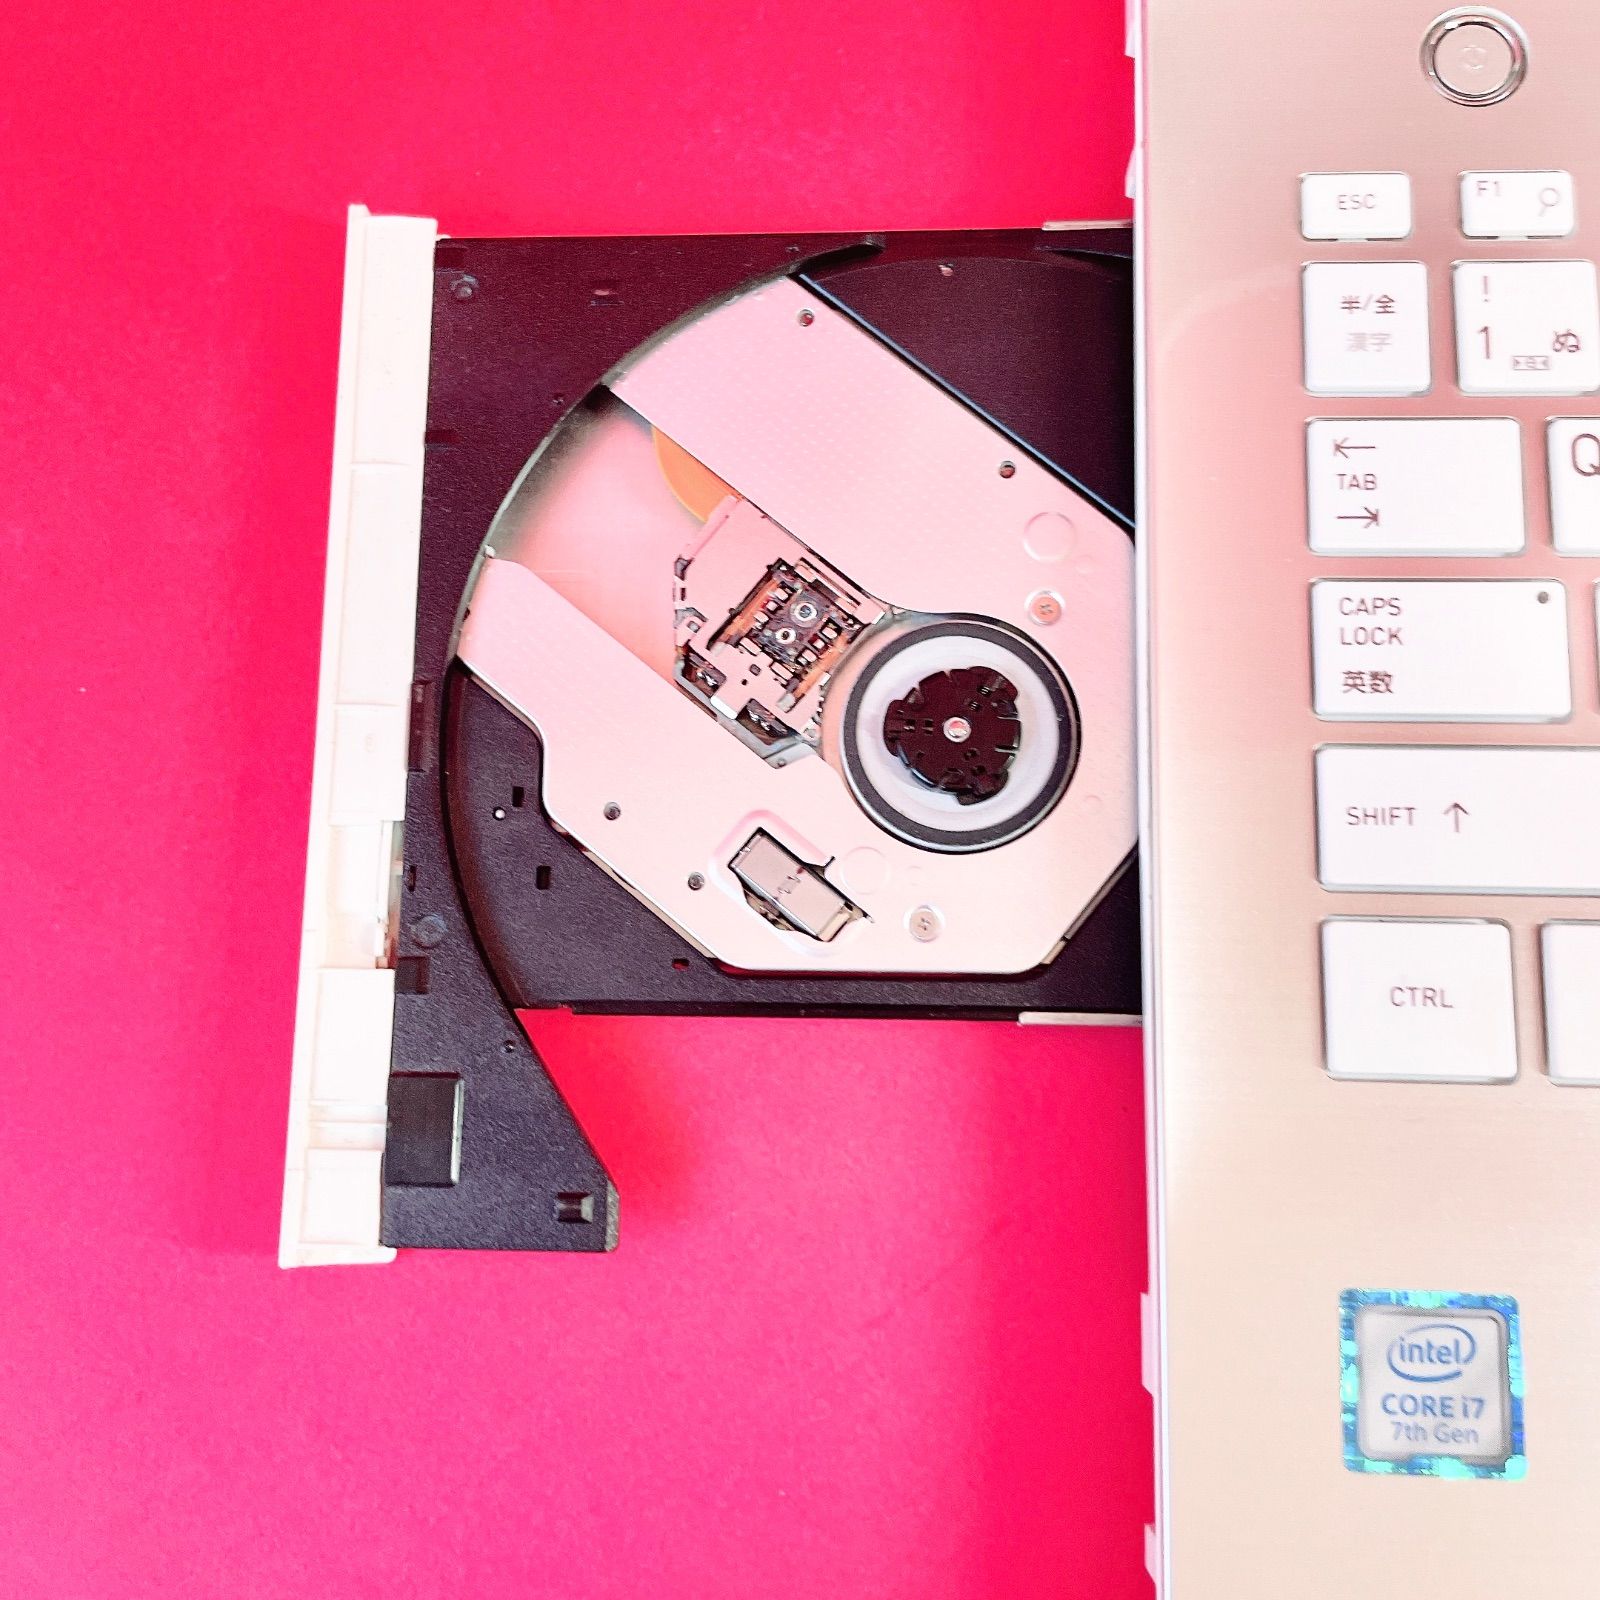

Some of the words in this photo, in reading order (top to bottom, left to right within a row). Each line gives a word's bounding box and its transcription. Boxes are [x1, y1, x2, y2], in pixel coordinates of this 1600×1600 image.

[1476, 181, 1501, 197] F1
[1337, 194, 1377, 211] ESC
[1340, 294, 1396, 314] 半/全
[1478, 326, 1491, 360] 1
[1552, 329, 1582, 353] ぬ
[1571, 433, 1600, 477] Q
[1336, 473, 1377, 491] TAB
[1339, 597, 1403, 616] CAPS
[1339, 626, 1404, 646] LOCK
[1342, 670, 1393, 694] 英数
[1346, 806, 1416, 826] SHIFT
[1389, 986, 1454, 1008] CTRL
[1399, 1336, 1460, 1365] intel
[1381, 1393, 1454, 1418] CORE
[1462, 1395, 1485, 1419] i7
[1390, 1422, 1428, 1442] 7th
[1433, 1422, 1479, 1443] Gen
